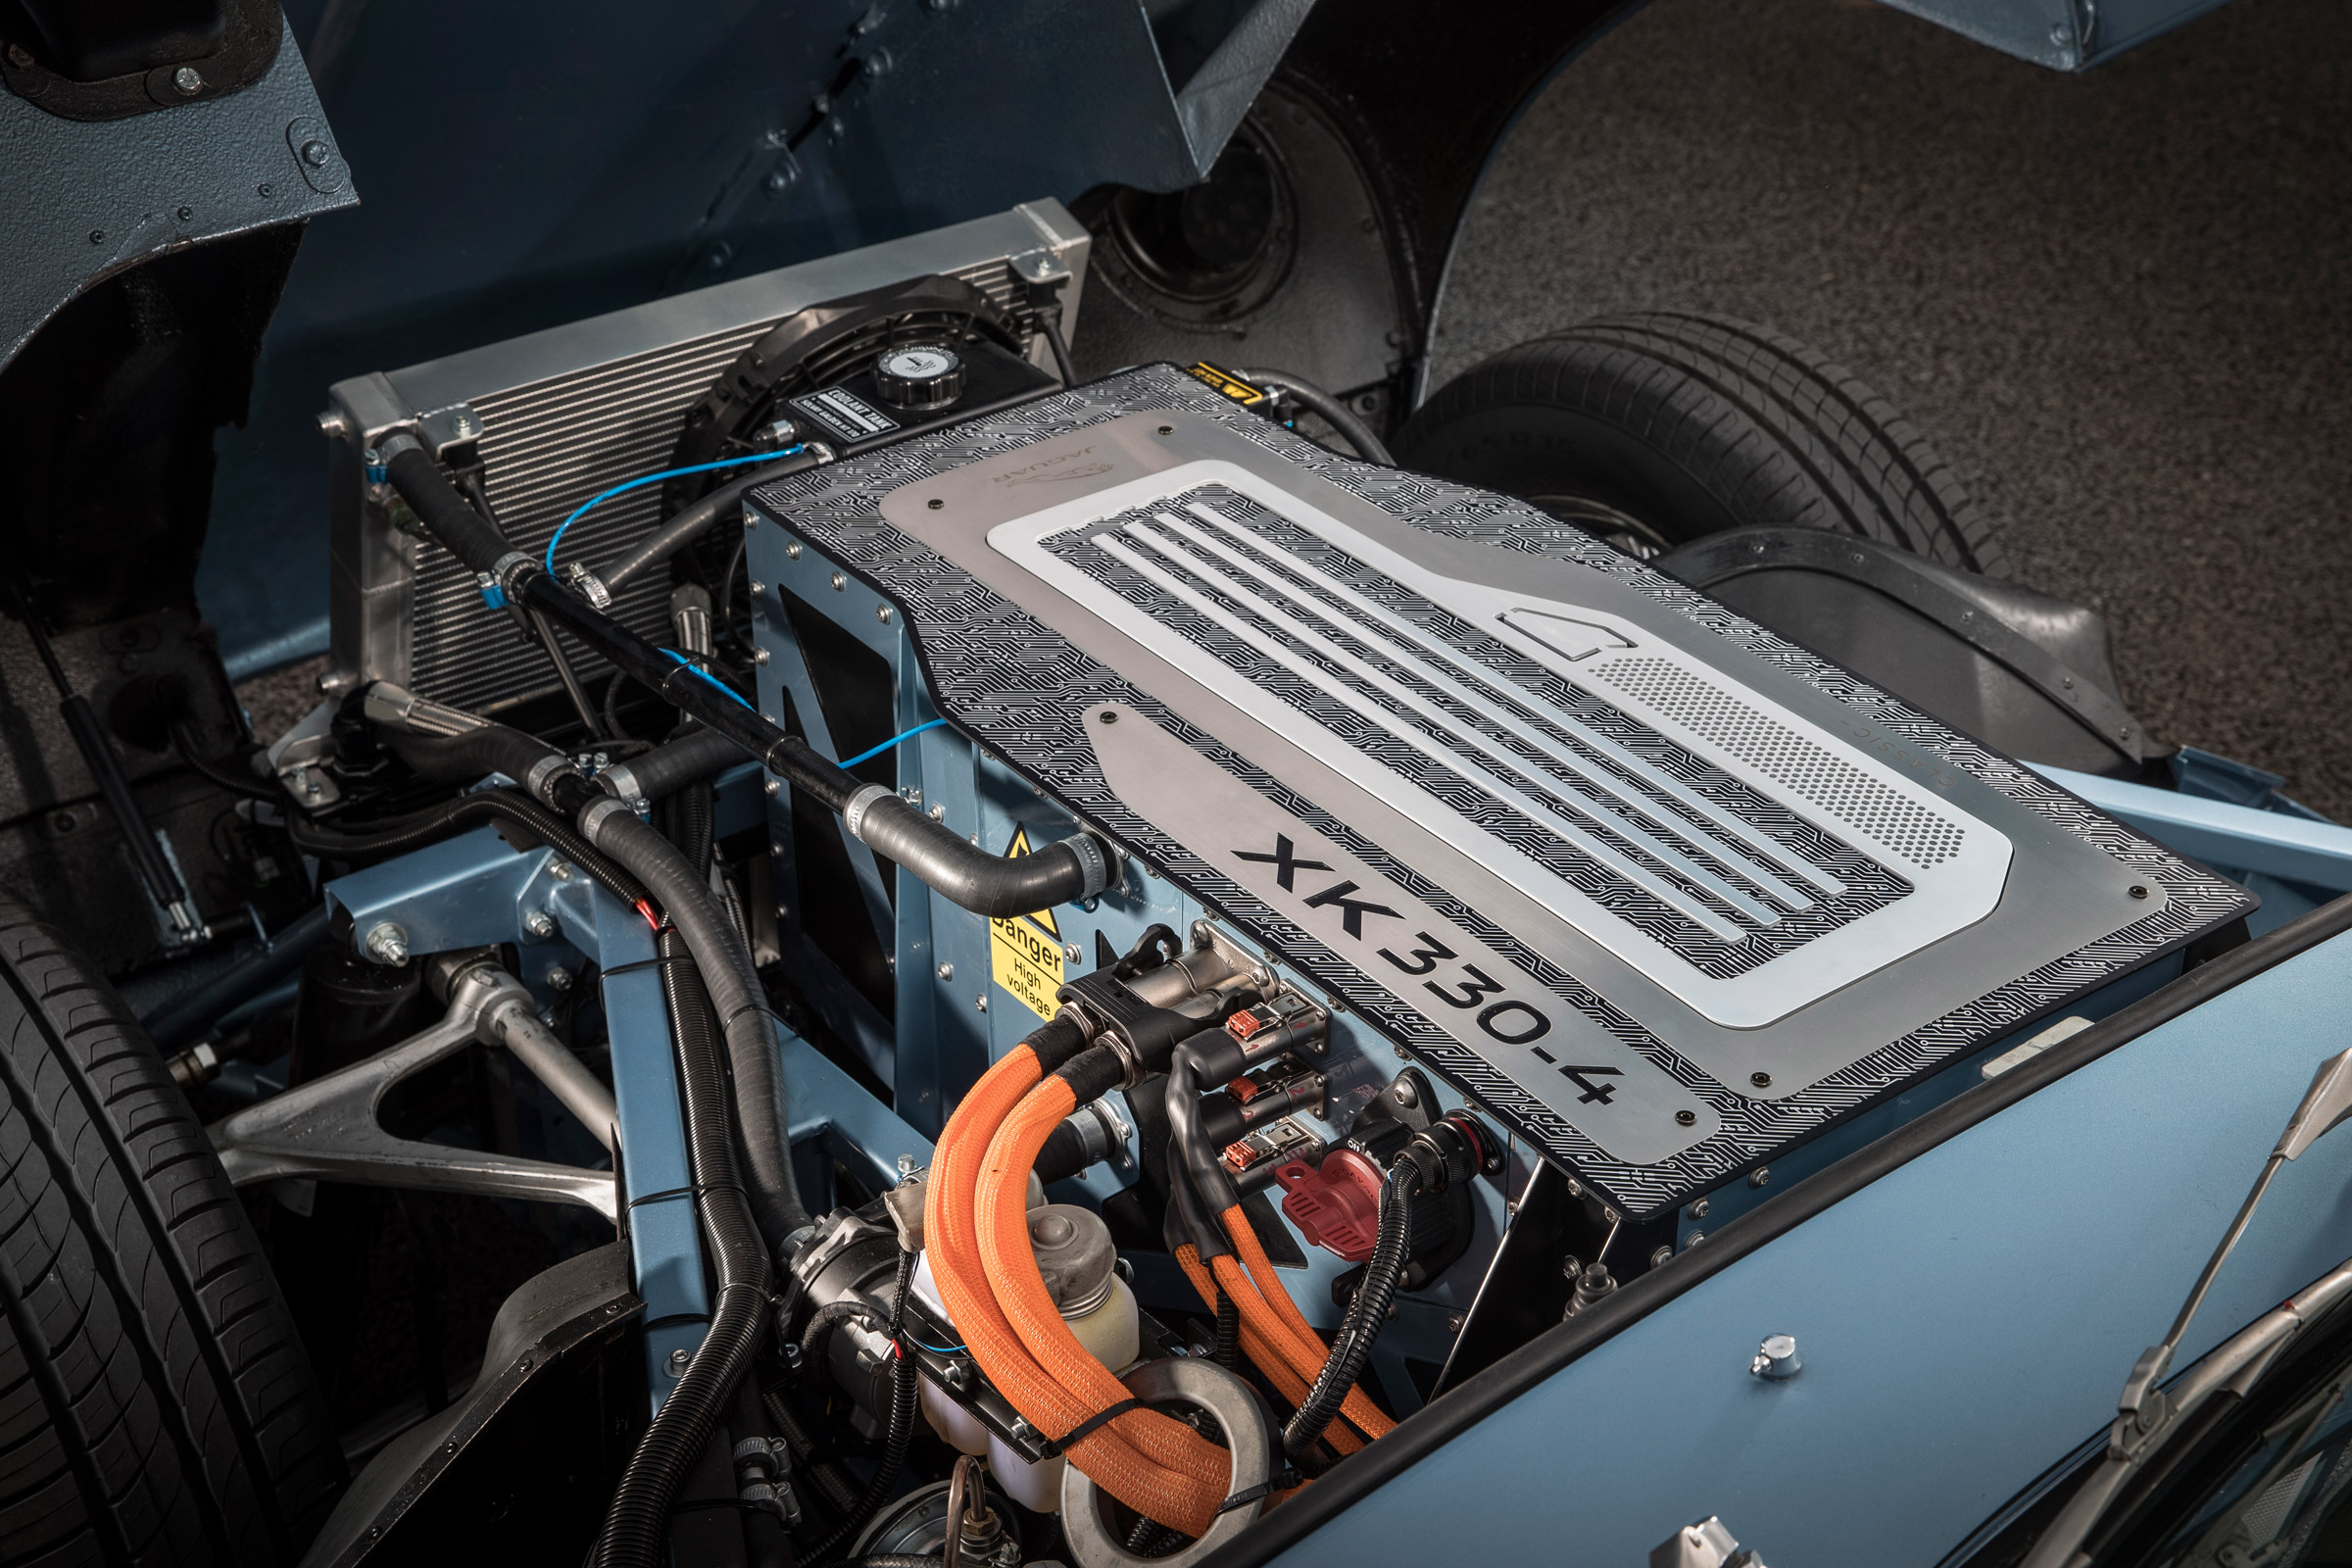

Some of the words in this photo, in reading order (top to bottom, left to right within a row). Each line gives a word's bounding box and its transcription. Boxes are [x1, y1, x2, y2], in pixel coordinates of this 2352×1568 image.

[827, 389, 870, 414] COOLANT
[864, 411, 893, 429] TANK
[992, 445, 1097, 483] JAGUAR
[1853, 728, 1956, 787] CLASSIC
[1013, 957, 1042, 990] High
[1229, 832, 1626, 1106] XK330-4
[1006, 974, 1052, 1016] voltage
[1348, 1139, 1361, 1152] OFF
